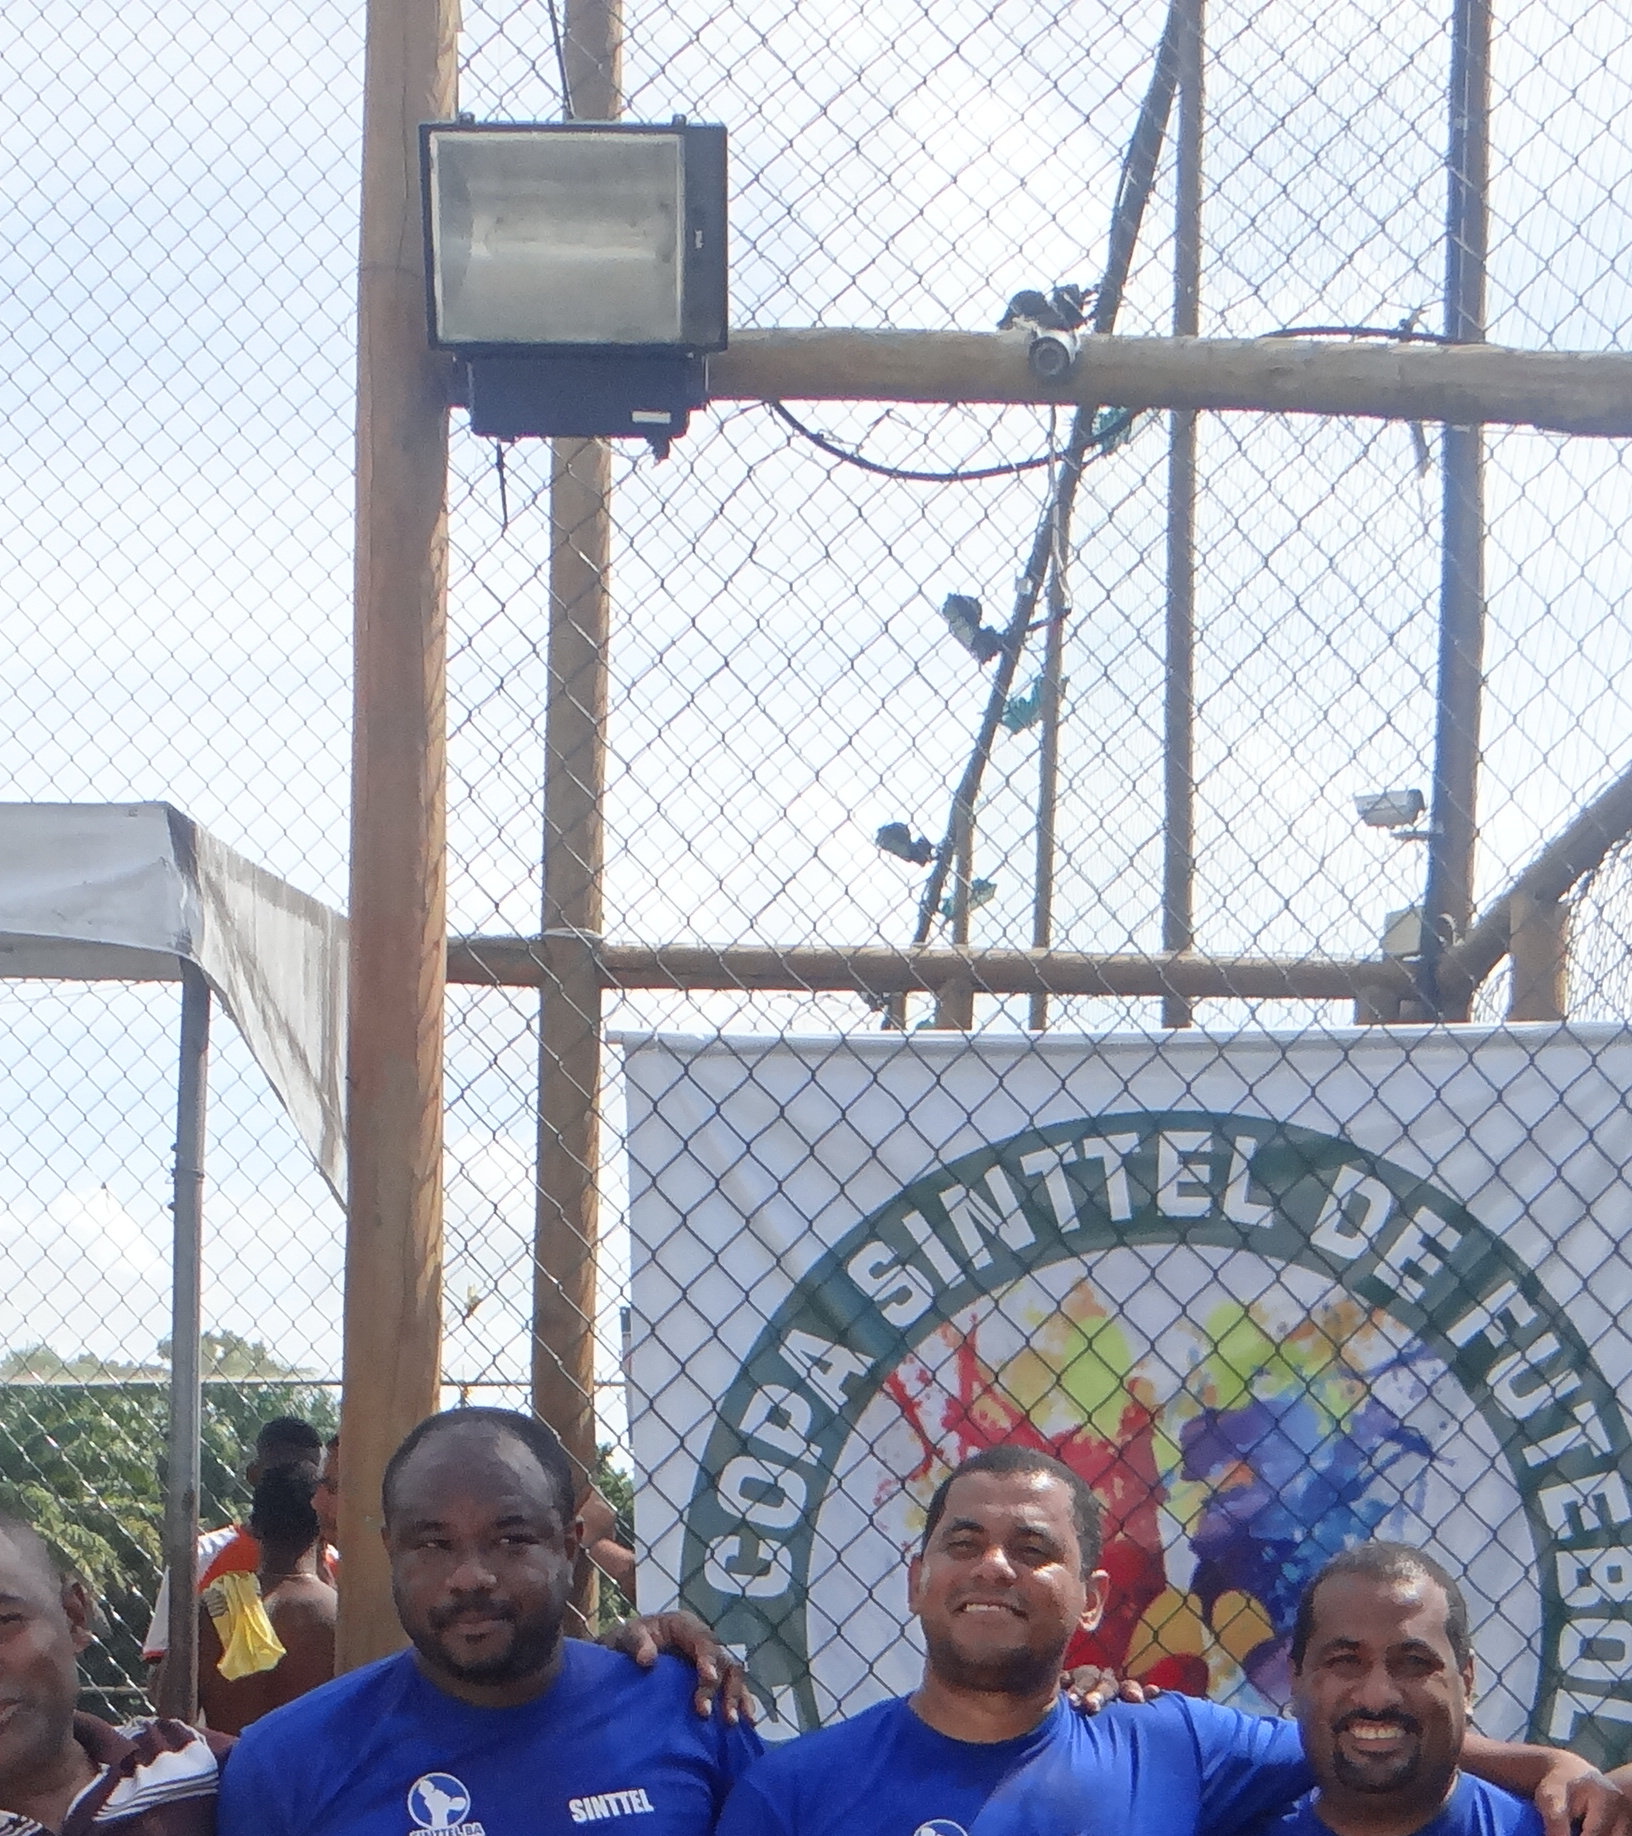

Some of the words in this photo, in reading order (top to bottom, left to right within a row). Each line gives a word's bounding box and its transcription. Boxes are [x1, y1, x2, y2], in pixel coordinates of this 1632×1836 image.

[704, 1349, 876, 1598] COPA
[846, 1130, 1274, 1328] SINTTEL
[1310, 1164, 1462, 1304] DE
[569, 1788, 655, 1823] SINTTEL
[464, 1824, 483, 1836] BA
